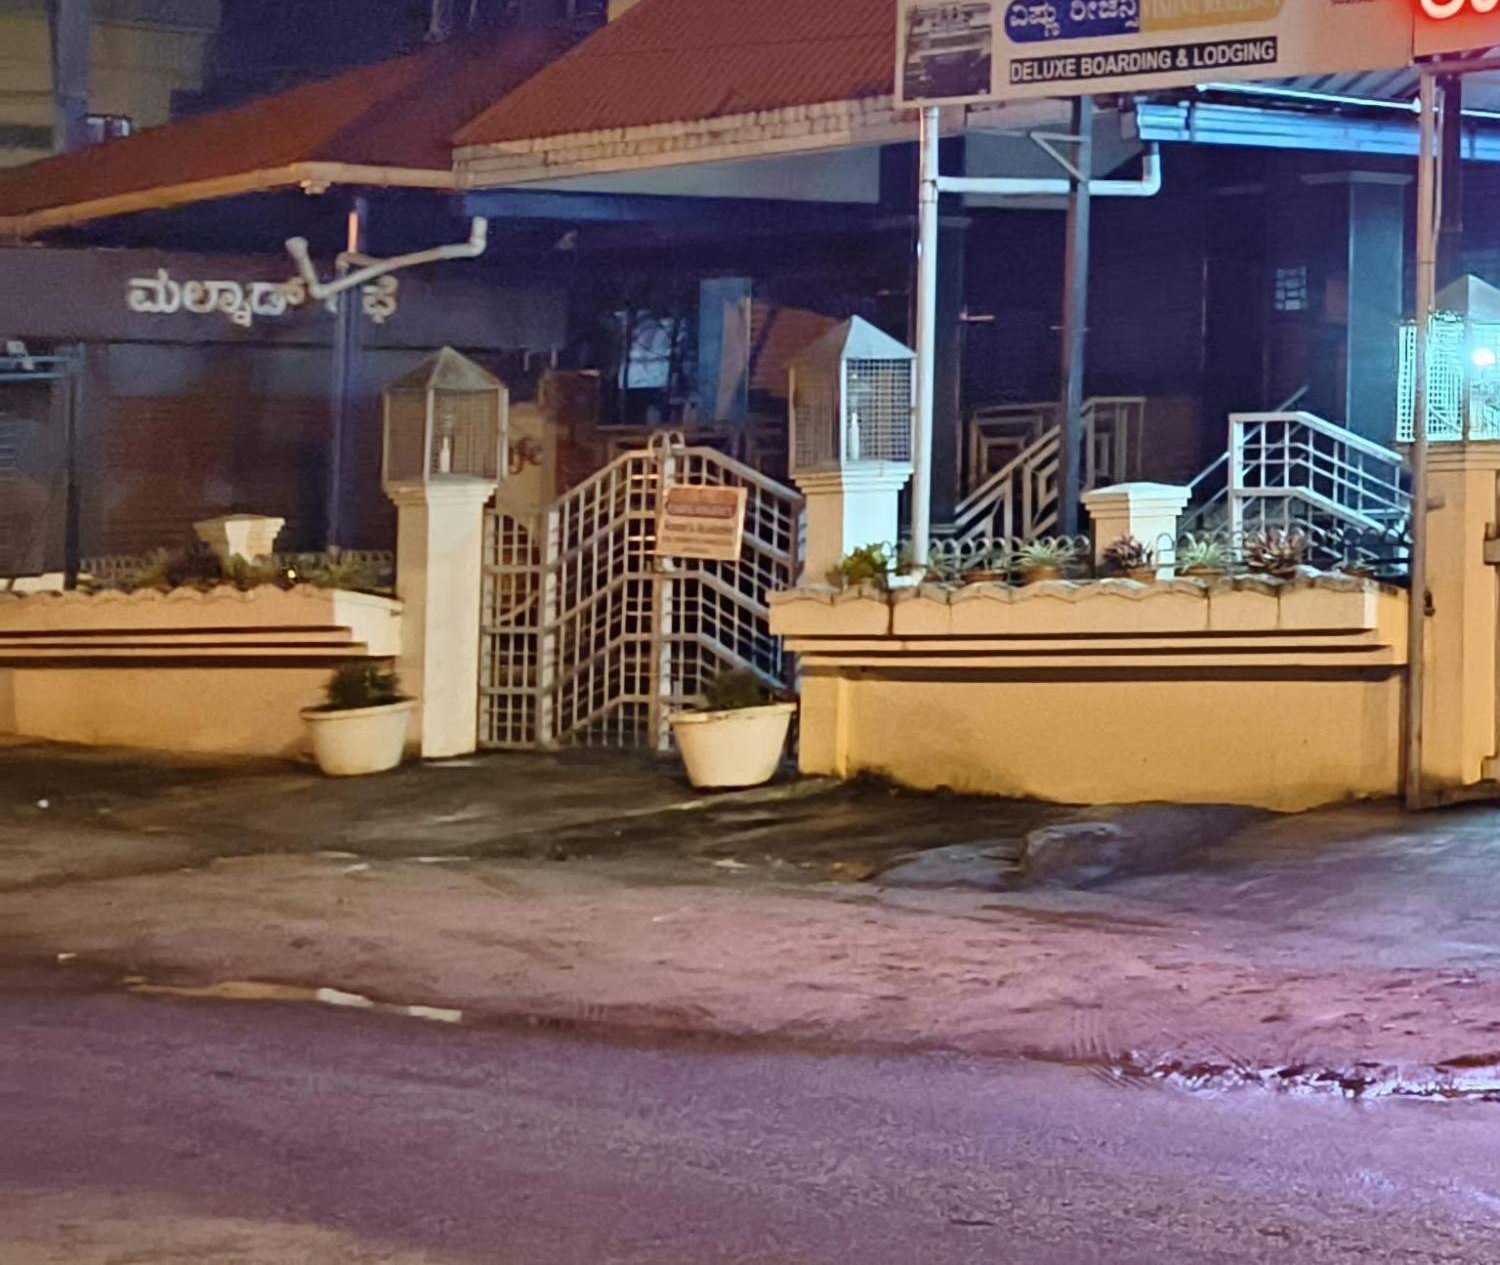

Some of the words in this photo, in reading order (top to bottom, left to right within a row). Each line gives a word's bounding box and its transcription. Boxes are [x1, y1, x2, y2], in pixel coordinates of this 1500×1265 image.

[1009, 0, 1061, 38] ವಿಷ್ಣು
[1011, 58, 1077, 82] DELUXE
[1080, 50, 1172, 76] BOARDING
[1176, 48, 1189, 68] &
[1193, 40, 1275, 66] LODGING
[128, 267, 307, 327] ಮಲ್ನಾಡ್
